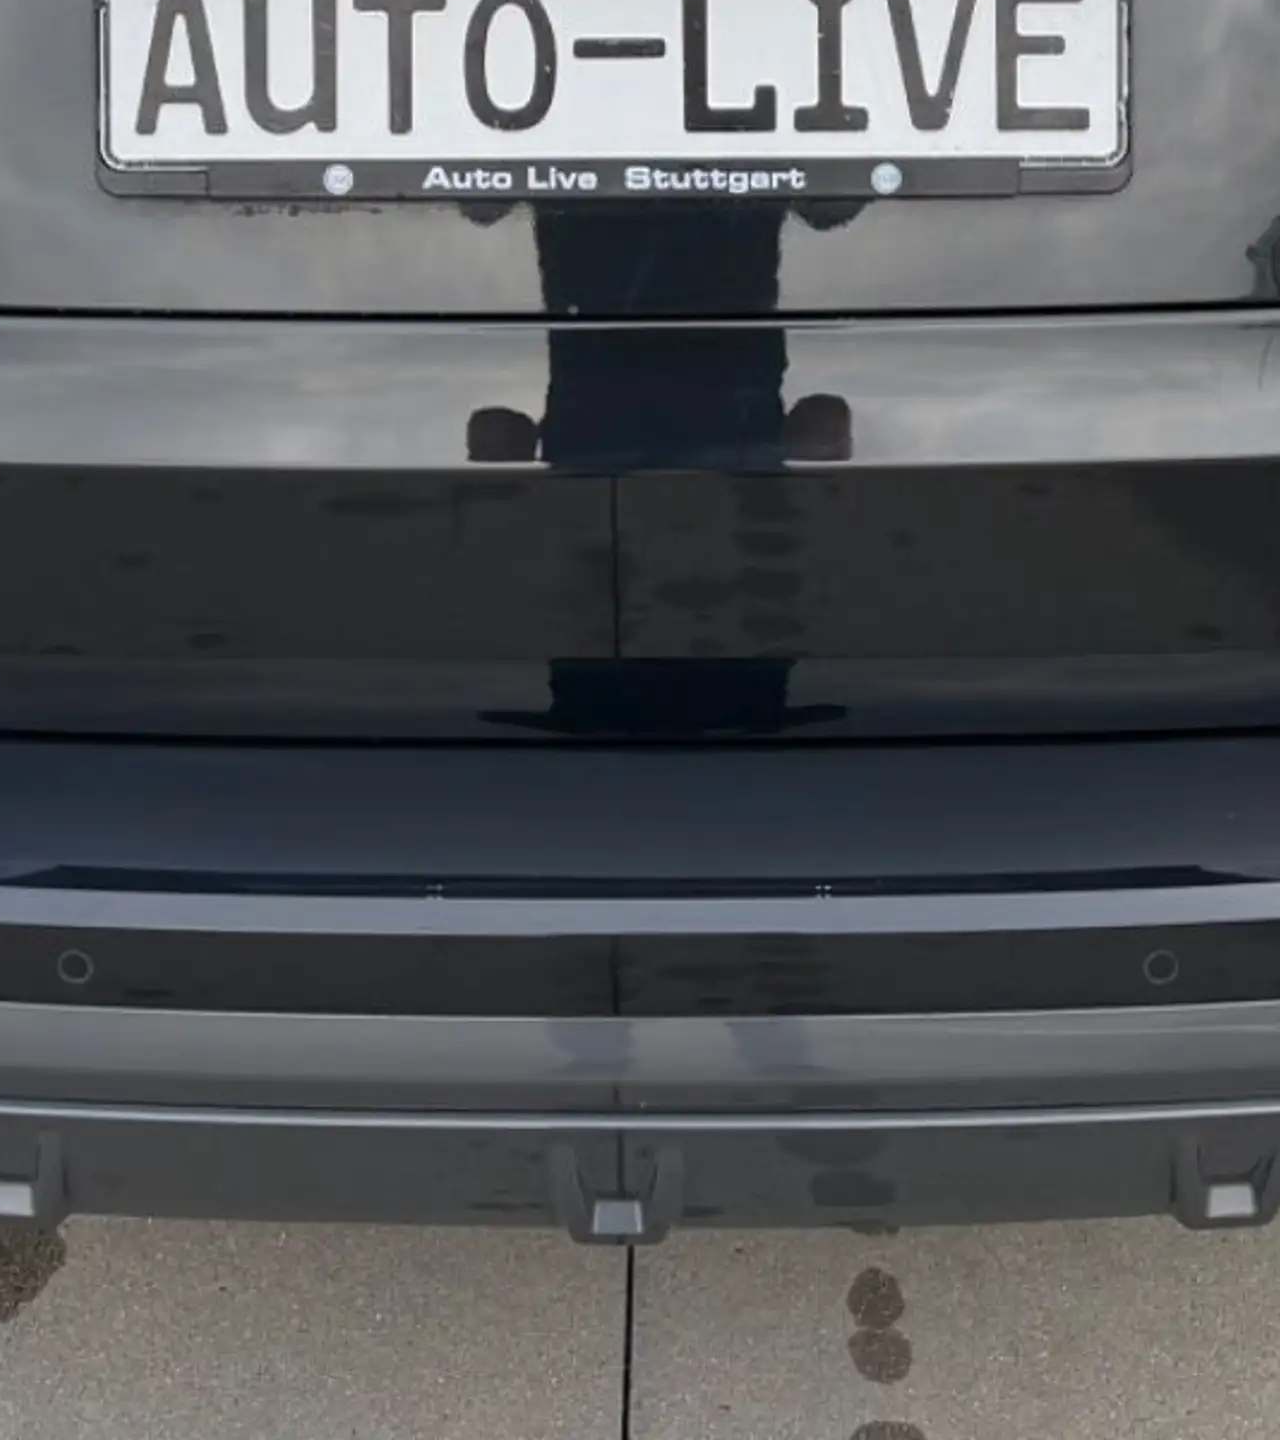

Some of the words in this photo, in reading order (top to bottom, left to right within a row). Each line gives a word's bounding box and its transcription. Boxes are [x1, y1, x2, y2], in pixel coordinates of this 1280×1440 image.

[421, 165, 514, 191] Auto
[526, 165, 599, 191] Live
[623, 165, 808, 194] Stuttgart
